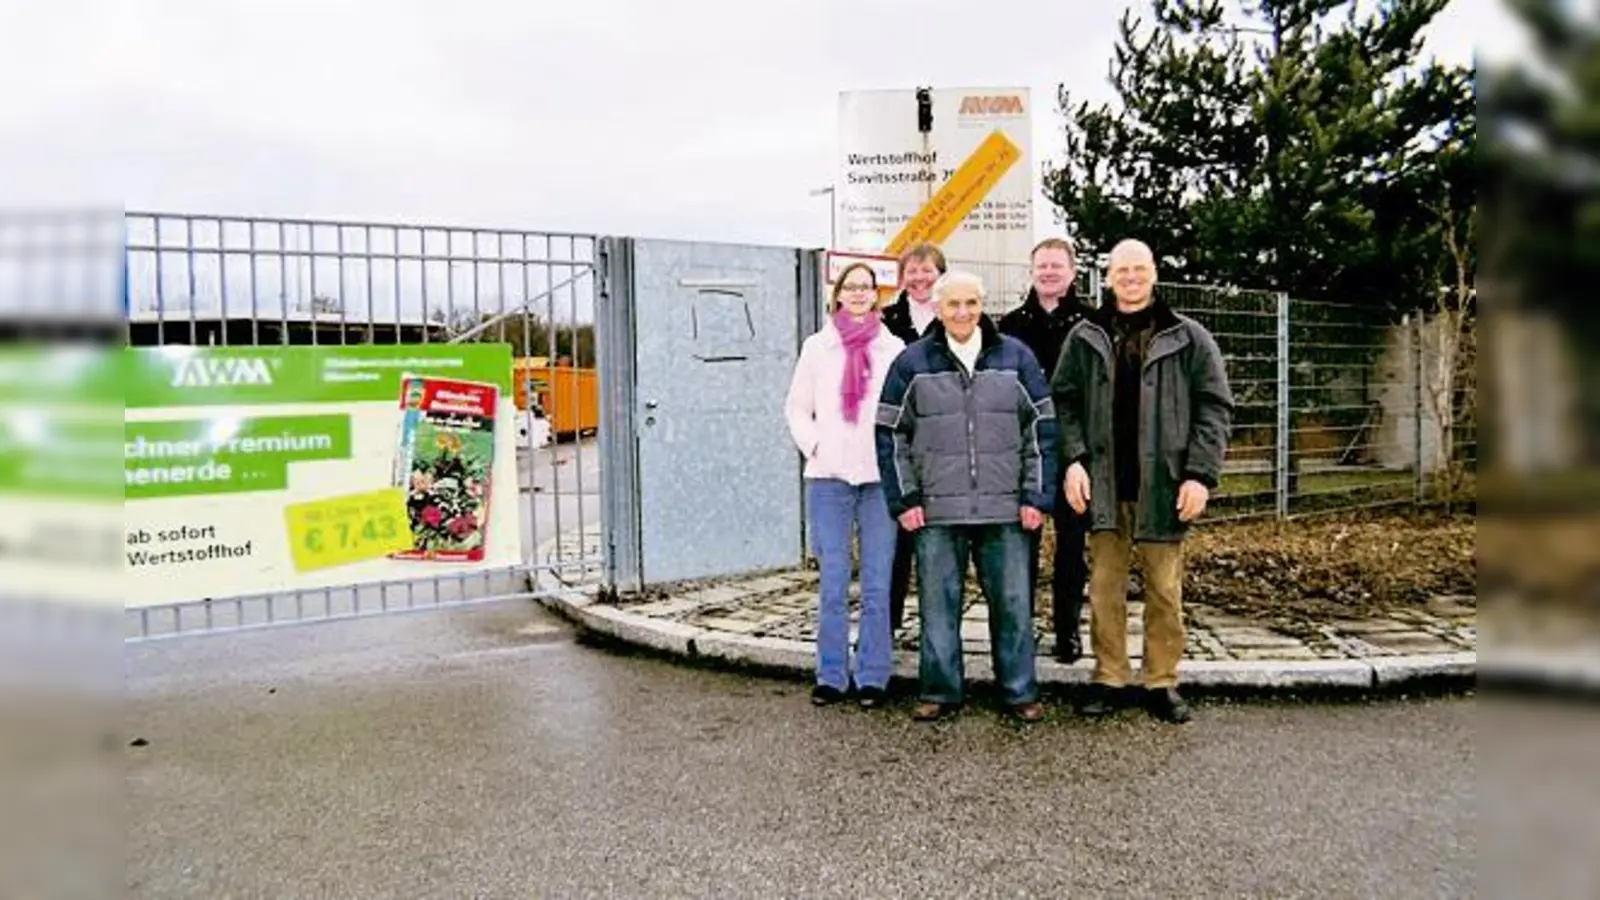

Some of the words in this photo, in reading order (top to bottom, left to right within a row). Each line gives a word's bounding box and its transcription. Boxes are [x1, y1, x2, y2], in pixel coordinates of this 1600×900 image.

[847, 151, 937, 165] Wertstoffhof
[847, 168, 937, 184] Savitsstraße
[171, 357, 273, 387] AWM
[126, 529, 152, 545] ab
[157, 525, 216, 542] sofort
[126, 539, 252, 566] Wertstoffhof
